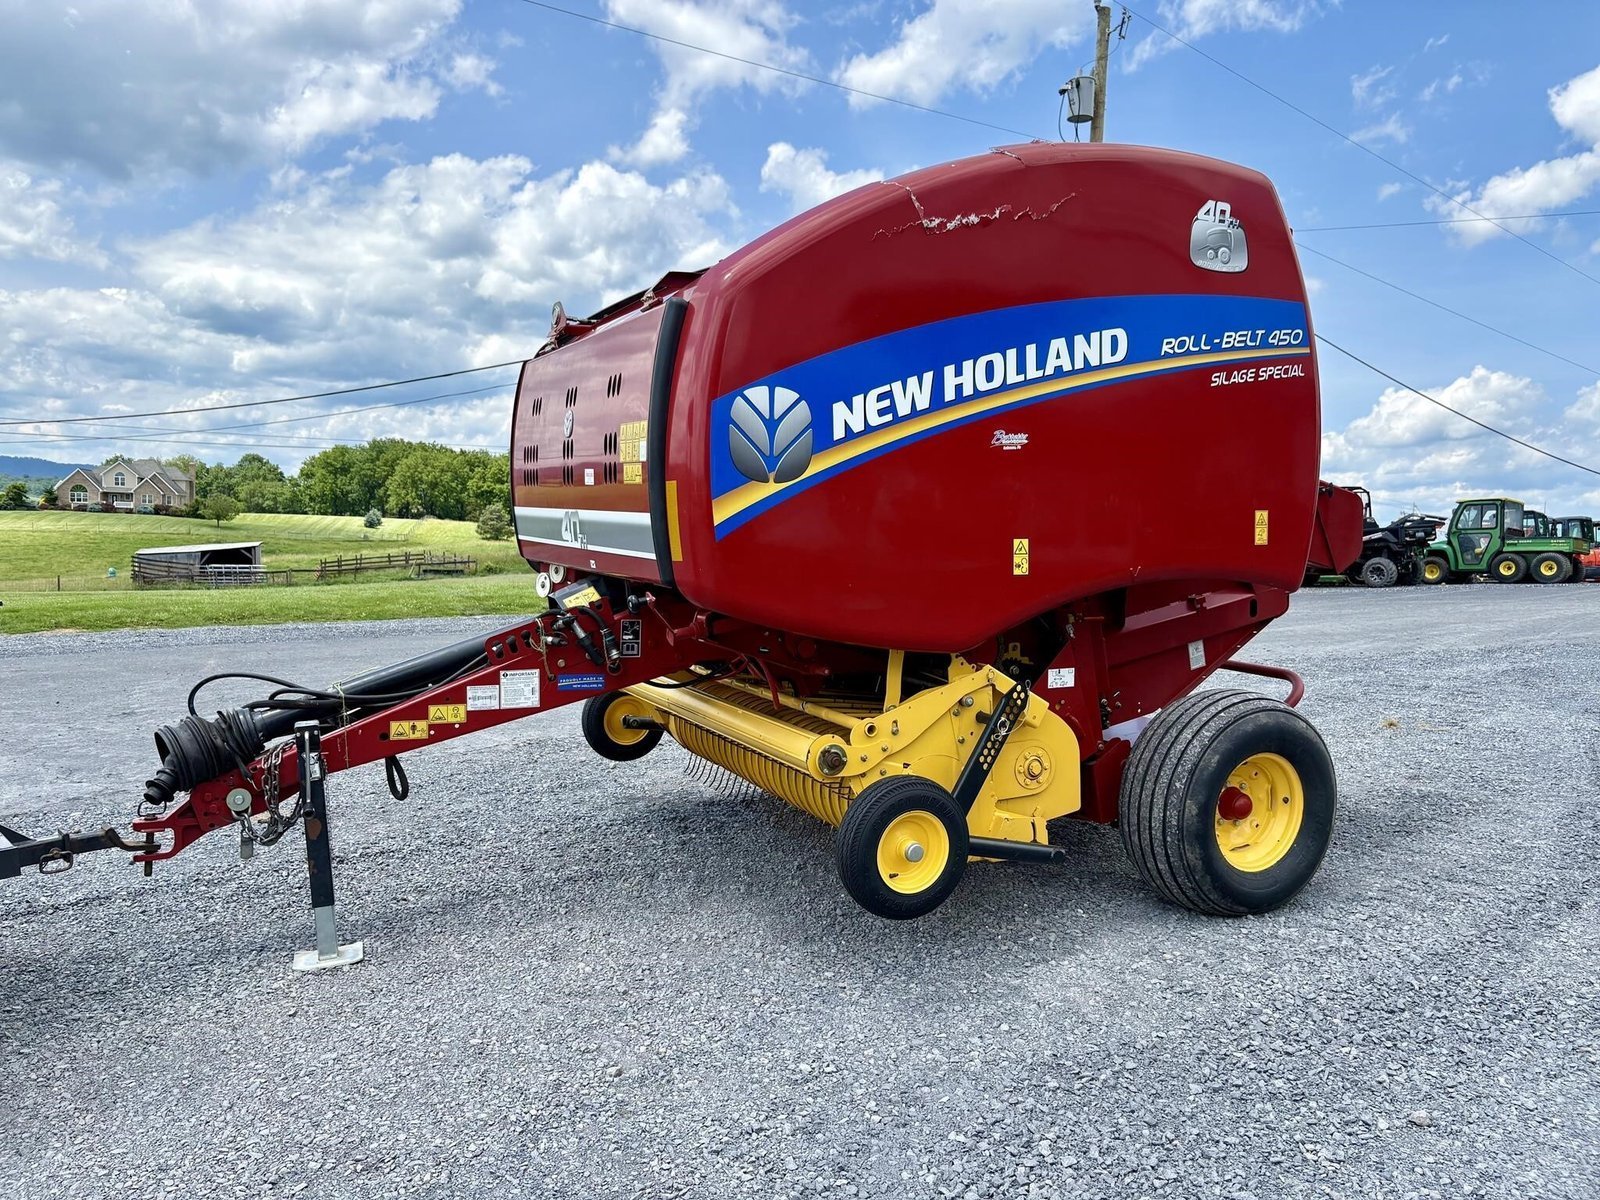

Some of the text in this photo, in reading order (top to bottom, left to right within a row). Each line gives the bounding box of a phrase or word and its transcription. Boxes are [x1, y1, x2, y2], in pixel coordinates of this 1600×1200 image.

[1160, 329, 1303, 356] ROLL-BELT 450
[832, 327, 1128, 441] NEW HOLLAND
[1210, 364, 1305, 387] SILAGE SPECIAL
